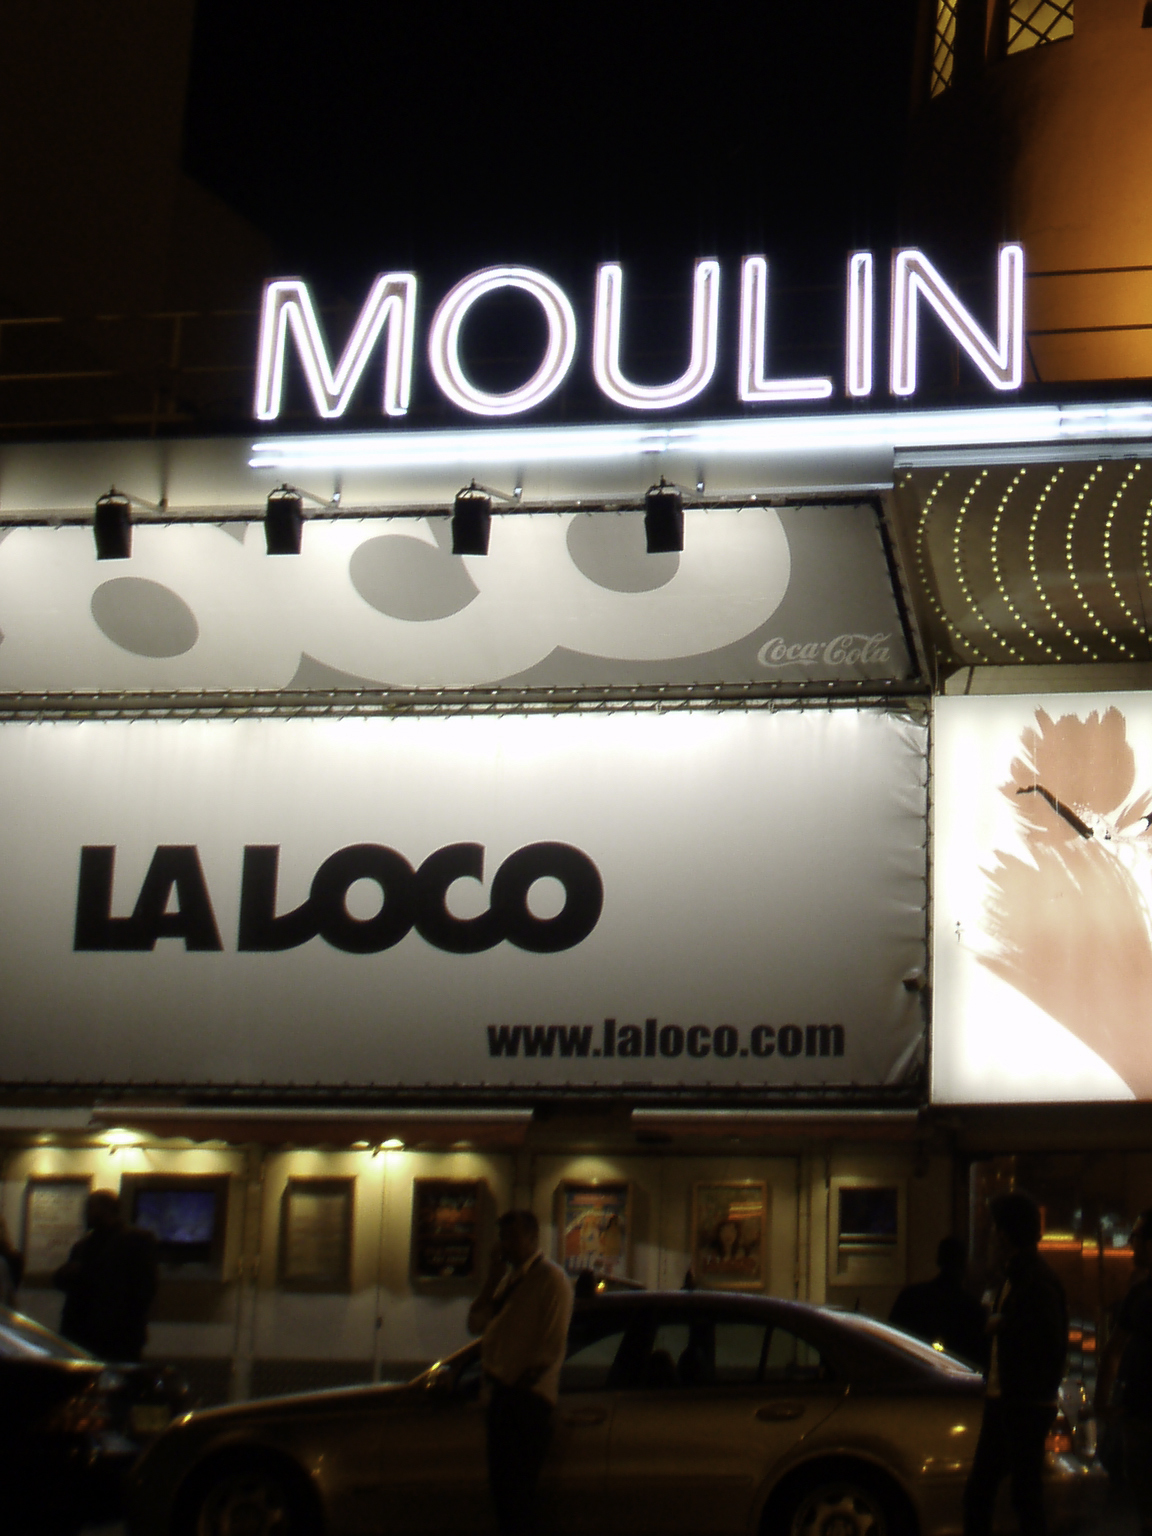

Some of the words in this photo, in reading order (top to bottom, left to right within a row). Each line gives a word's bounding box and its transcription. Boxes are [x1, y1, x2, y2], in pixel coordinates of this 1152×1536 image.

[254, 242, 1025, 421] MOULIN
[757, 632, 892, 668] Coca-Cola
[73, 844, 224, 952] LA
[237, 840, 604, 955] LOCO
[487, 1018, 846, 1059] www.laloco.com
